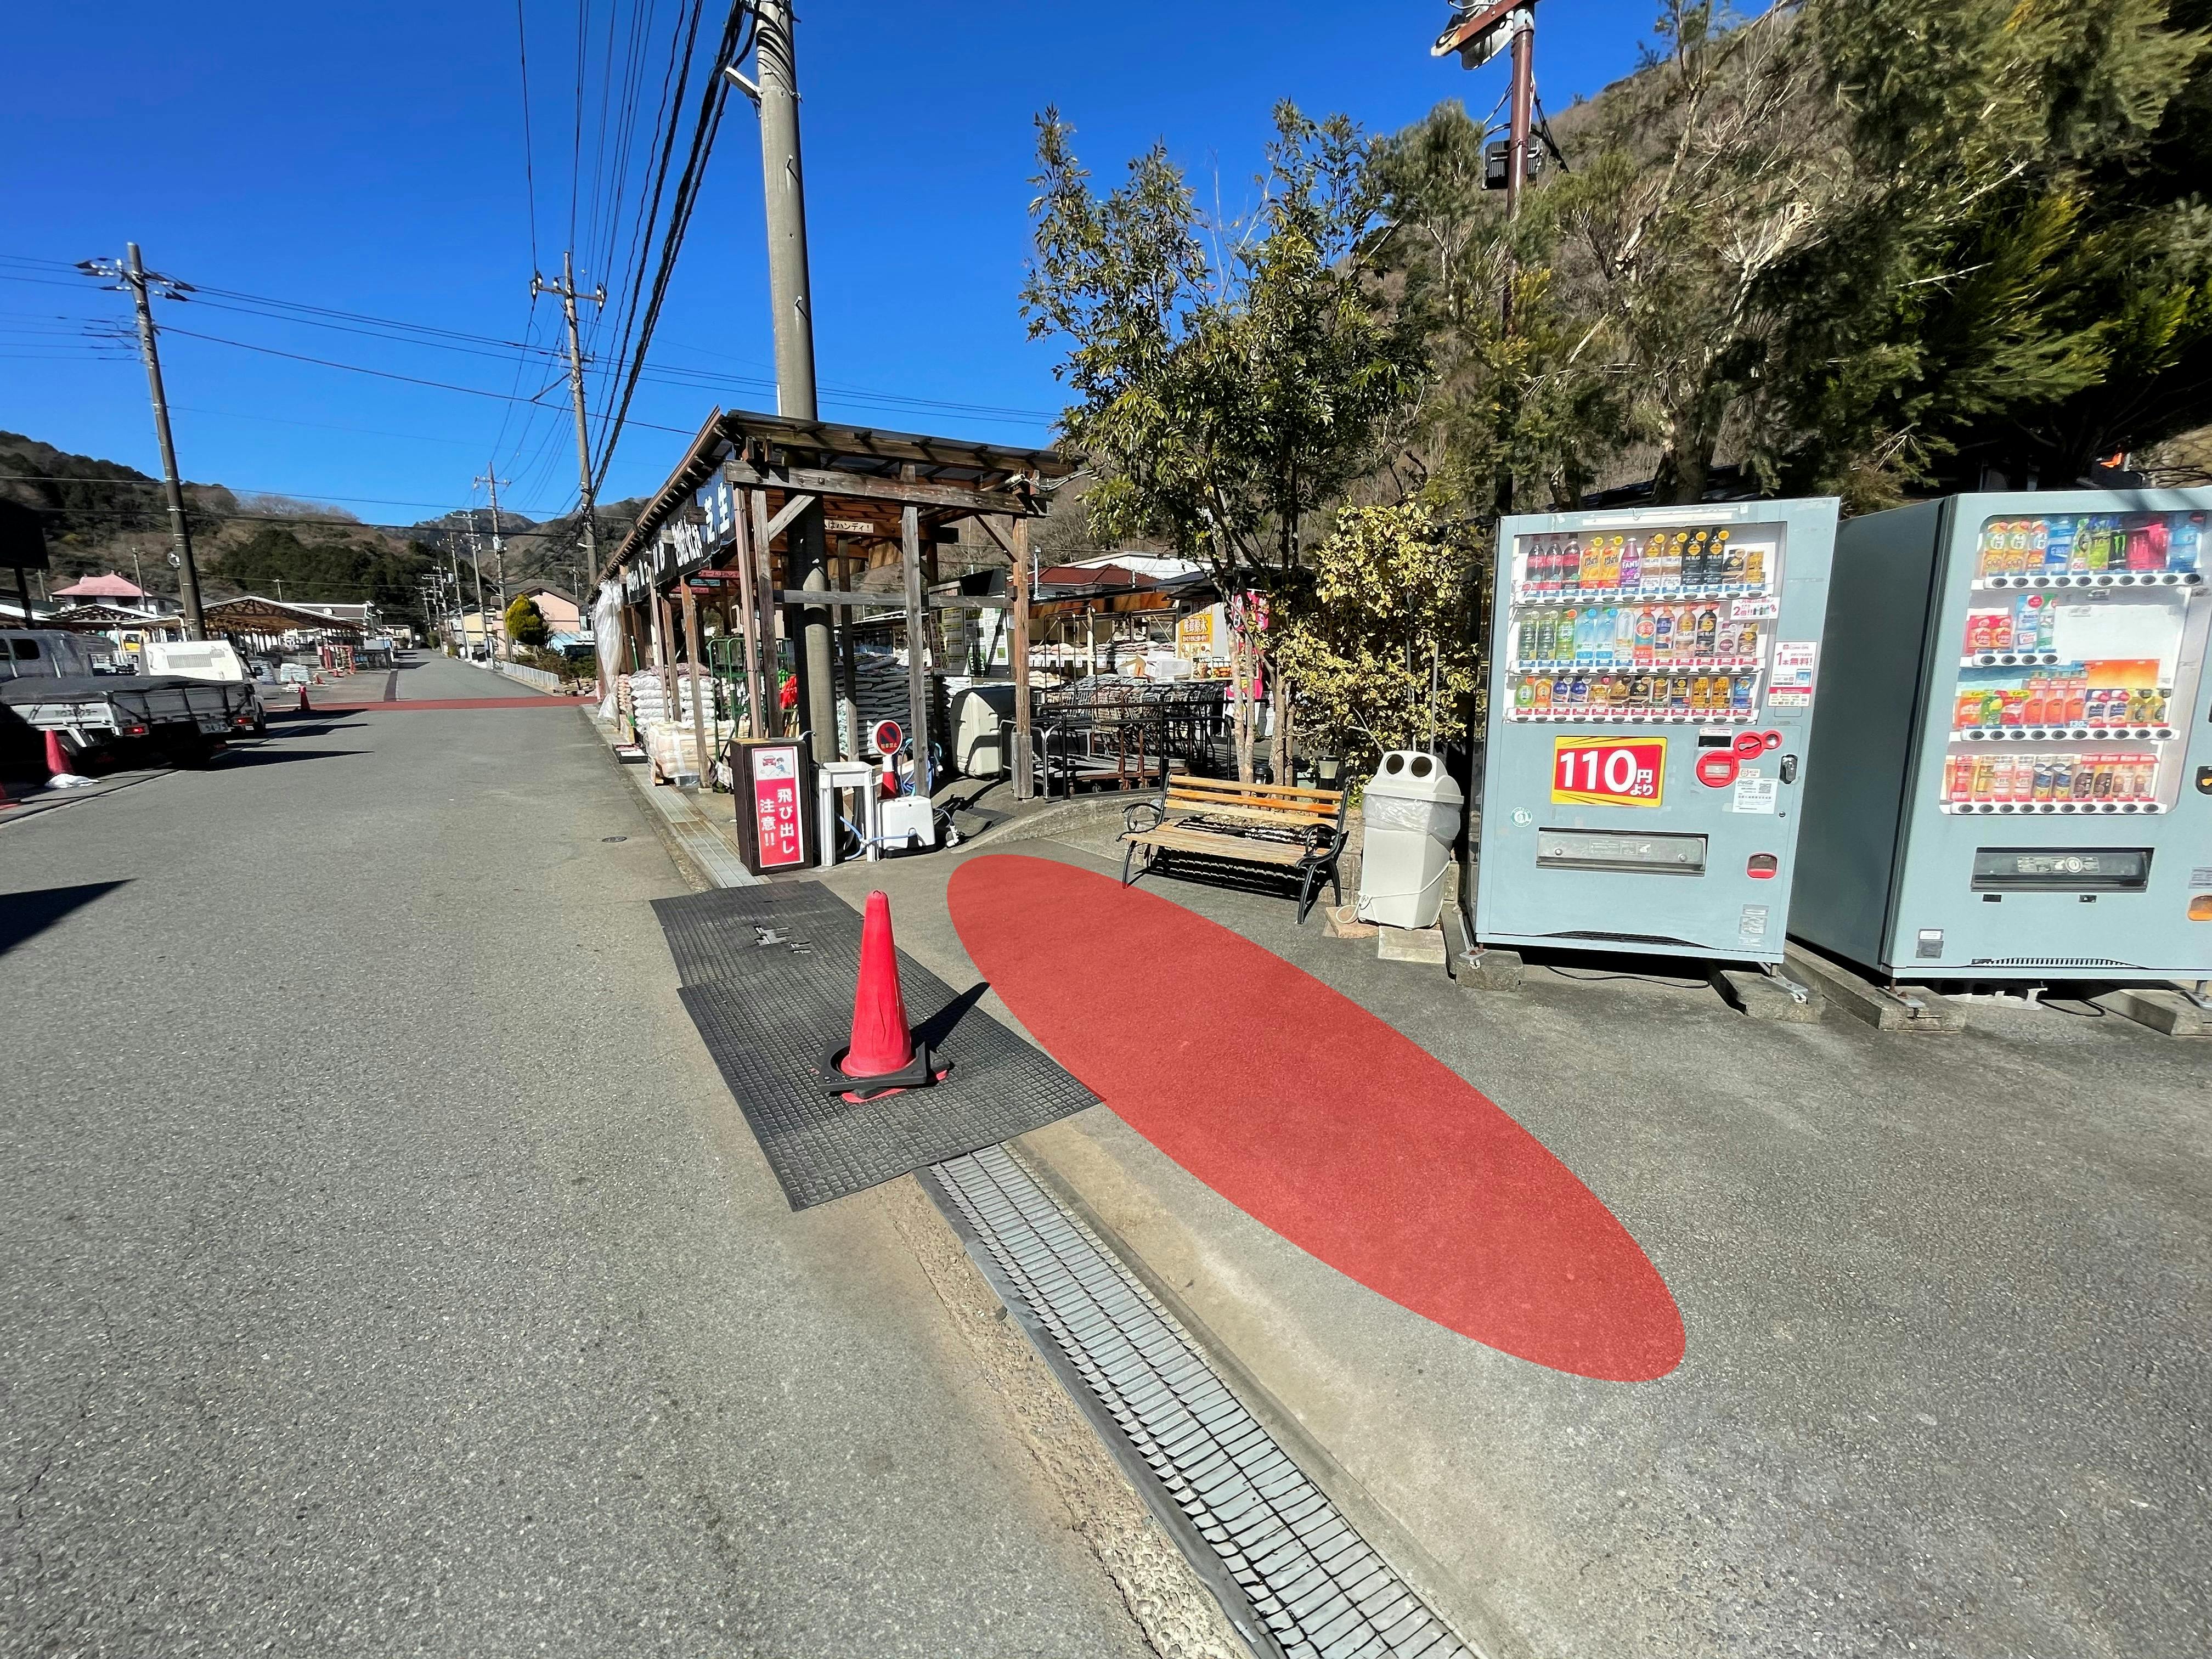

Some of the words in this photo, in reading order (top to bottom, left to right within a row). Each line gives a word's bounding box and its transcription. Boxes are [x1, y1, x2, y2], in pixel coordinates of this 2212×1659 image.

[825, 521, 870, 532] はハンディ！
[777, 788, 795, 854] 飛び出し
